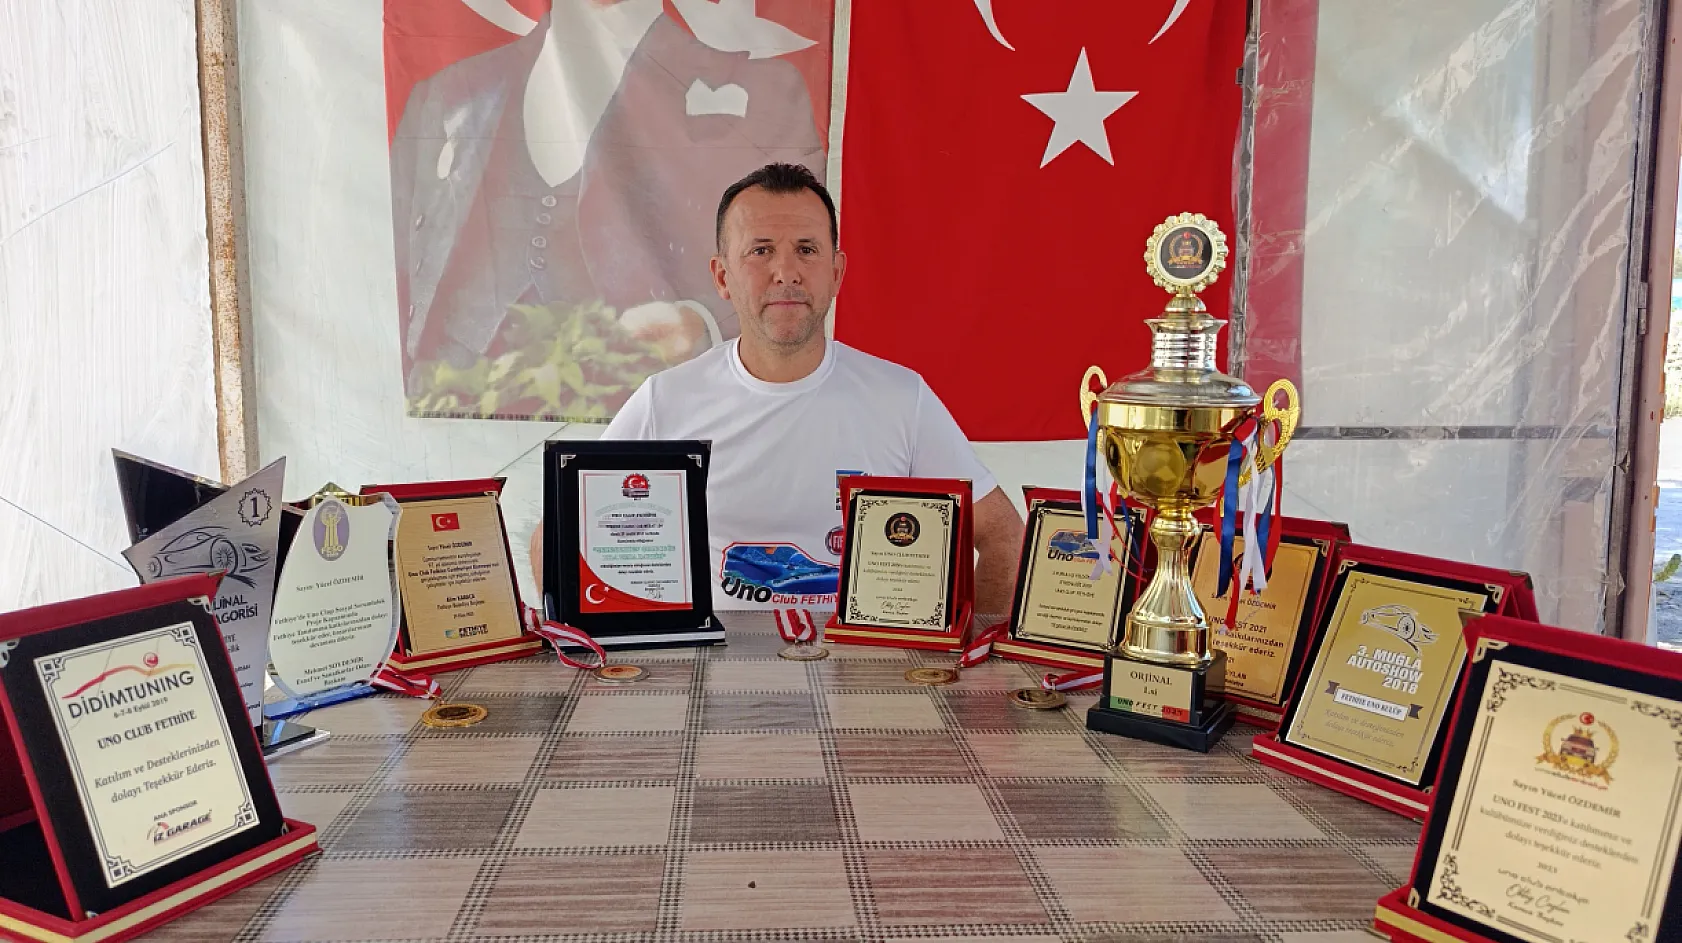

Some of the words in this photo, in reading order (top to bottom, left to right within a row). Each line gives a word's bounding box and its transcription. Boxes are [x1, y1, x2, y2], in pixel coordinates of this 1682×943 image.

[1048, 547, 1074, 562] Uno
[721, 576, 773, 603] Uno
[772, 594, 798, 605] Club
[1346, 655, 1425, 683] AUTOSHOW
[1382, 676, 1419, 695] 2018
[97, 734, 122, 750] UNO
[124, 724, 154, 741] CLUB
[94, 768, 132, 788] Katılım
[134, 764, 144, 775] ve
[111, 786, 142, 804] dolayı
[1492, 793, 1516, 808] UNO
[1516, 800, 1541, 816] FEST
